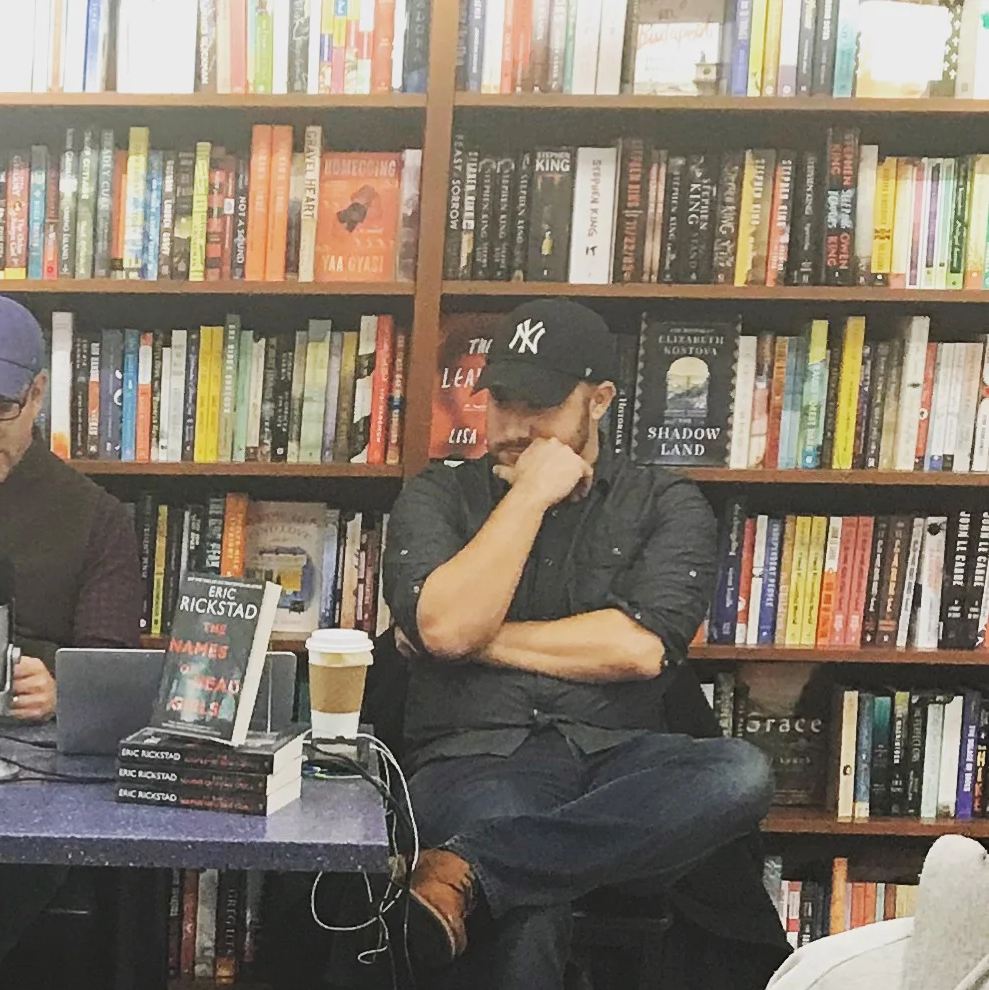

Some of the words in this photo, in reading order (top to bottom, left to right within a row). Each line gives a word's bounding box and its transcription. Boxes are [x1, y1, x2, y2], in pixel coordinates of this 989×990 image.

[305, 130, 317, 174] GRAVEL
[536, 151, 571, 159] STEPHEN
[829, 143, 842, 177] KING
[324, 158, 397, 177] HOMEGOING
[535, 159, 571, 172] KING
[589, 160, 602, 204] STEPHEN
[753, 158, 766, 198] STEPHEN
[780, 159, 793, 199] STEPHEN
[303, 178, 316, 218] HEART
[670, 172, 682, 212] STEPHEN
[687, 183, 702, 225] KING
[699, 178, 713, 230] STEPHEN
[238, 196, 247, 217] NOT
[449, 179, 462, 230] SORROW
[750, 203, 762, 226] KING
[237, 219, 246, 227] A
[587, 208, 599, 237] KING
[667, 216, 678, 240] KING
[718, 205, 736, 235] KING
[235, 229, 246, 264] SOUND
[825, 236, 840, 267] KING
[838, 233, 852, 270] OWEN
[321, 254, 344, 272] YAA
[348, 254, 384, 272] GYASI
[508, 318, 546, 354] NY
[658, 335, 724, 345] ELIZABETH
[663, 346, 718, 356] KOSTOVA
[449, 428, 477, 444] LISA
[647, 427, 721, 440] SHADOW
[661, 443, 706, 456] LAND
[957, 512, 971, 538] JOHN
[975, 512, 989, 538] JOHN
[768, 524, 780, 576] INDEPENDENT
[956, 540, 966, 551] LE
[977, 541, 986, 552] LE
[208, 585, 237, 600] ERIC
[766, 578, 776, 608] PEOPLE
[179, 595, 258, 619] RICKSTAD
[203, 621, 228, 636] THE
[169, 637, 229, 660] NAMES
[746, 714, 823, 735] Grace
[121, 747, 140, 757] ERIC
[141, 749, 181, 761] RICKSTAD
[118, 767, 137, 778] ERIC
[138, 769, 178, 782] RICKSTAD
[118, 788, 137, 798] ERIC
[137, 790, 178, 802] RICKSTAD
